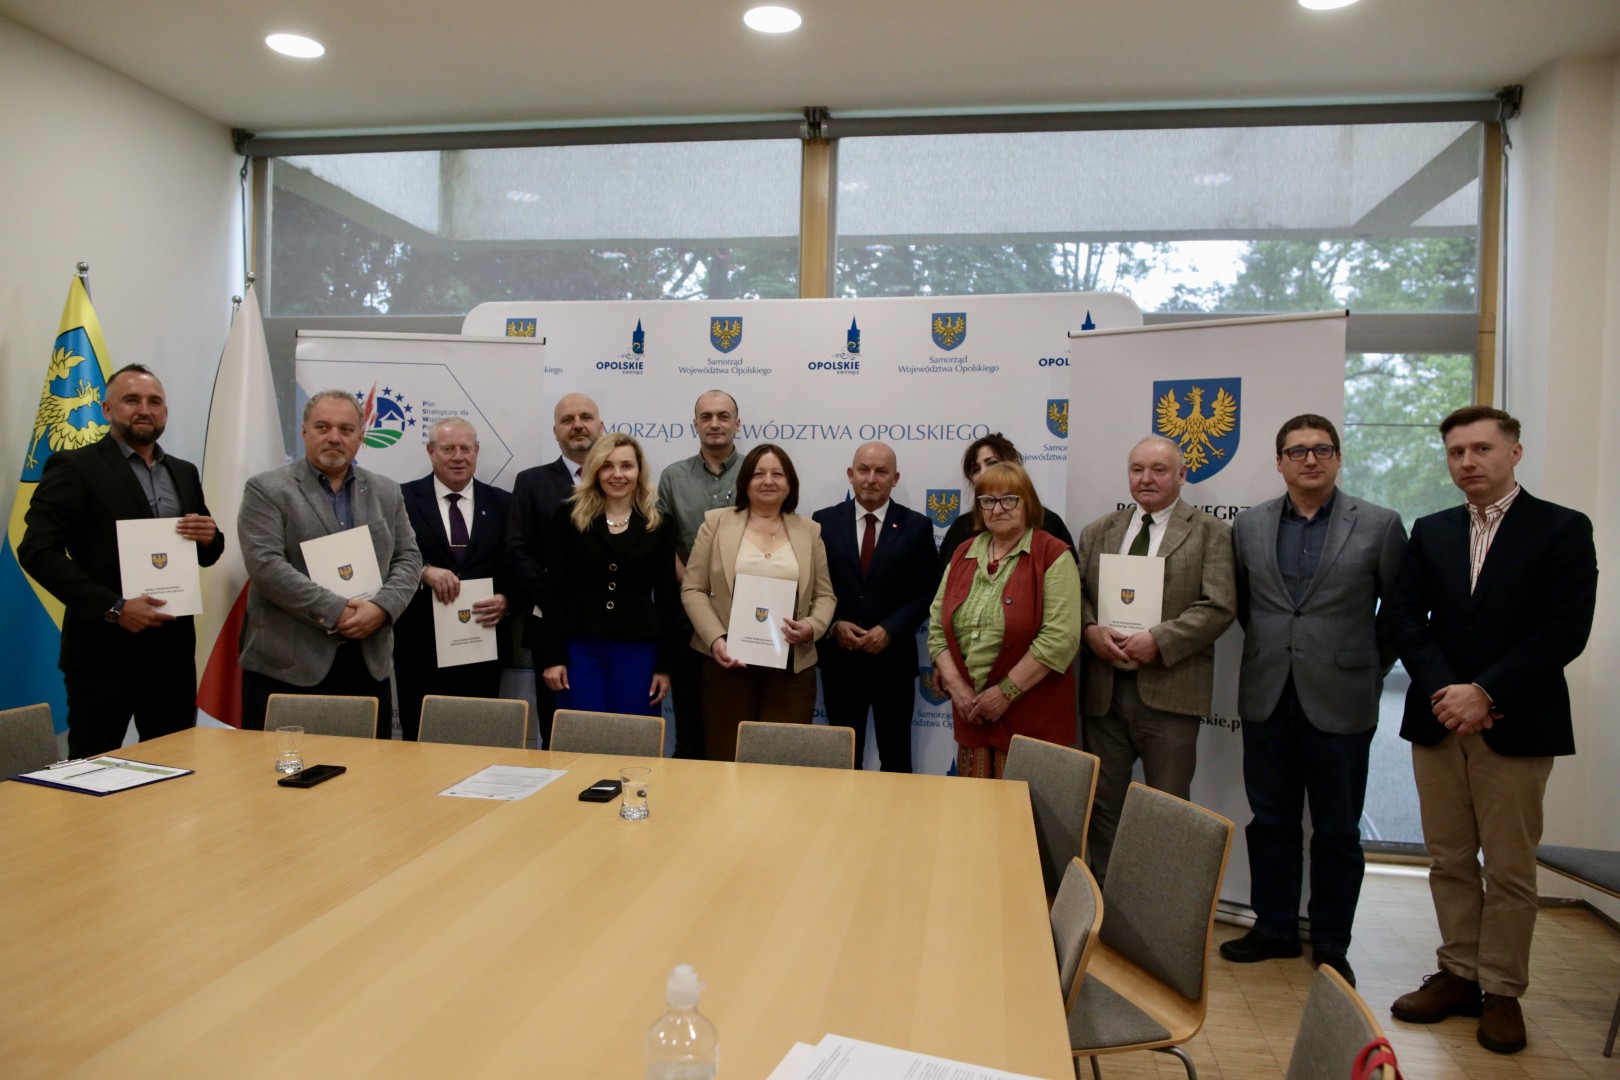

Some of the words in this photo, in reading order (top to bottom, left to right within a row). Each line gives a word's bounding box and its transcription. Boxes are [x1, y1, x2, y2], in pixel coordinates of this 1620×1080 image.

[707, 357, 743, 366] Samorząd
[929, 355, 968, 364] Samorząd
[1038, 357, 1070, 367] OPOL
[595, 361, 644, 370] OPOLSKIE
[808, 361, 860, 370] OPOLSKIE
[898, 365, 953, 375] Województwa
[955, 364, 999, 374] Opolskiego
[544, 365, 563, 376] kiego
[678, 366, 729, 376] Województwa
[731, 366, 772, 376] Opolskiego
[422, 408, 459, 417] Strategiczny
[602, 422, 684, 443] MORZĄD
[859, 424, 990, 441] OPOLSKIEGO
[1043, 443, 1068, 452] Samor
[1018, 453, 1067, 463] ojewództwa
